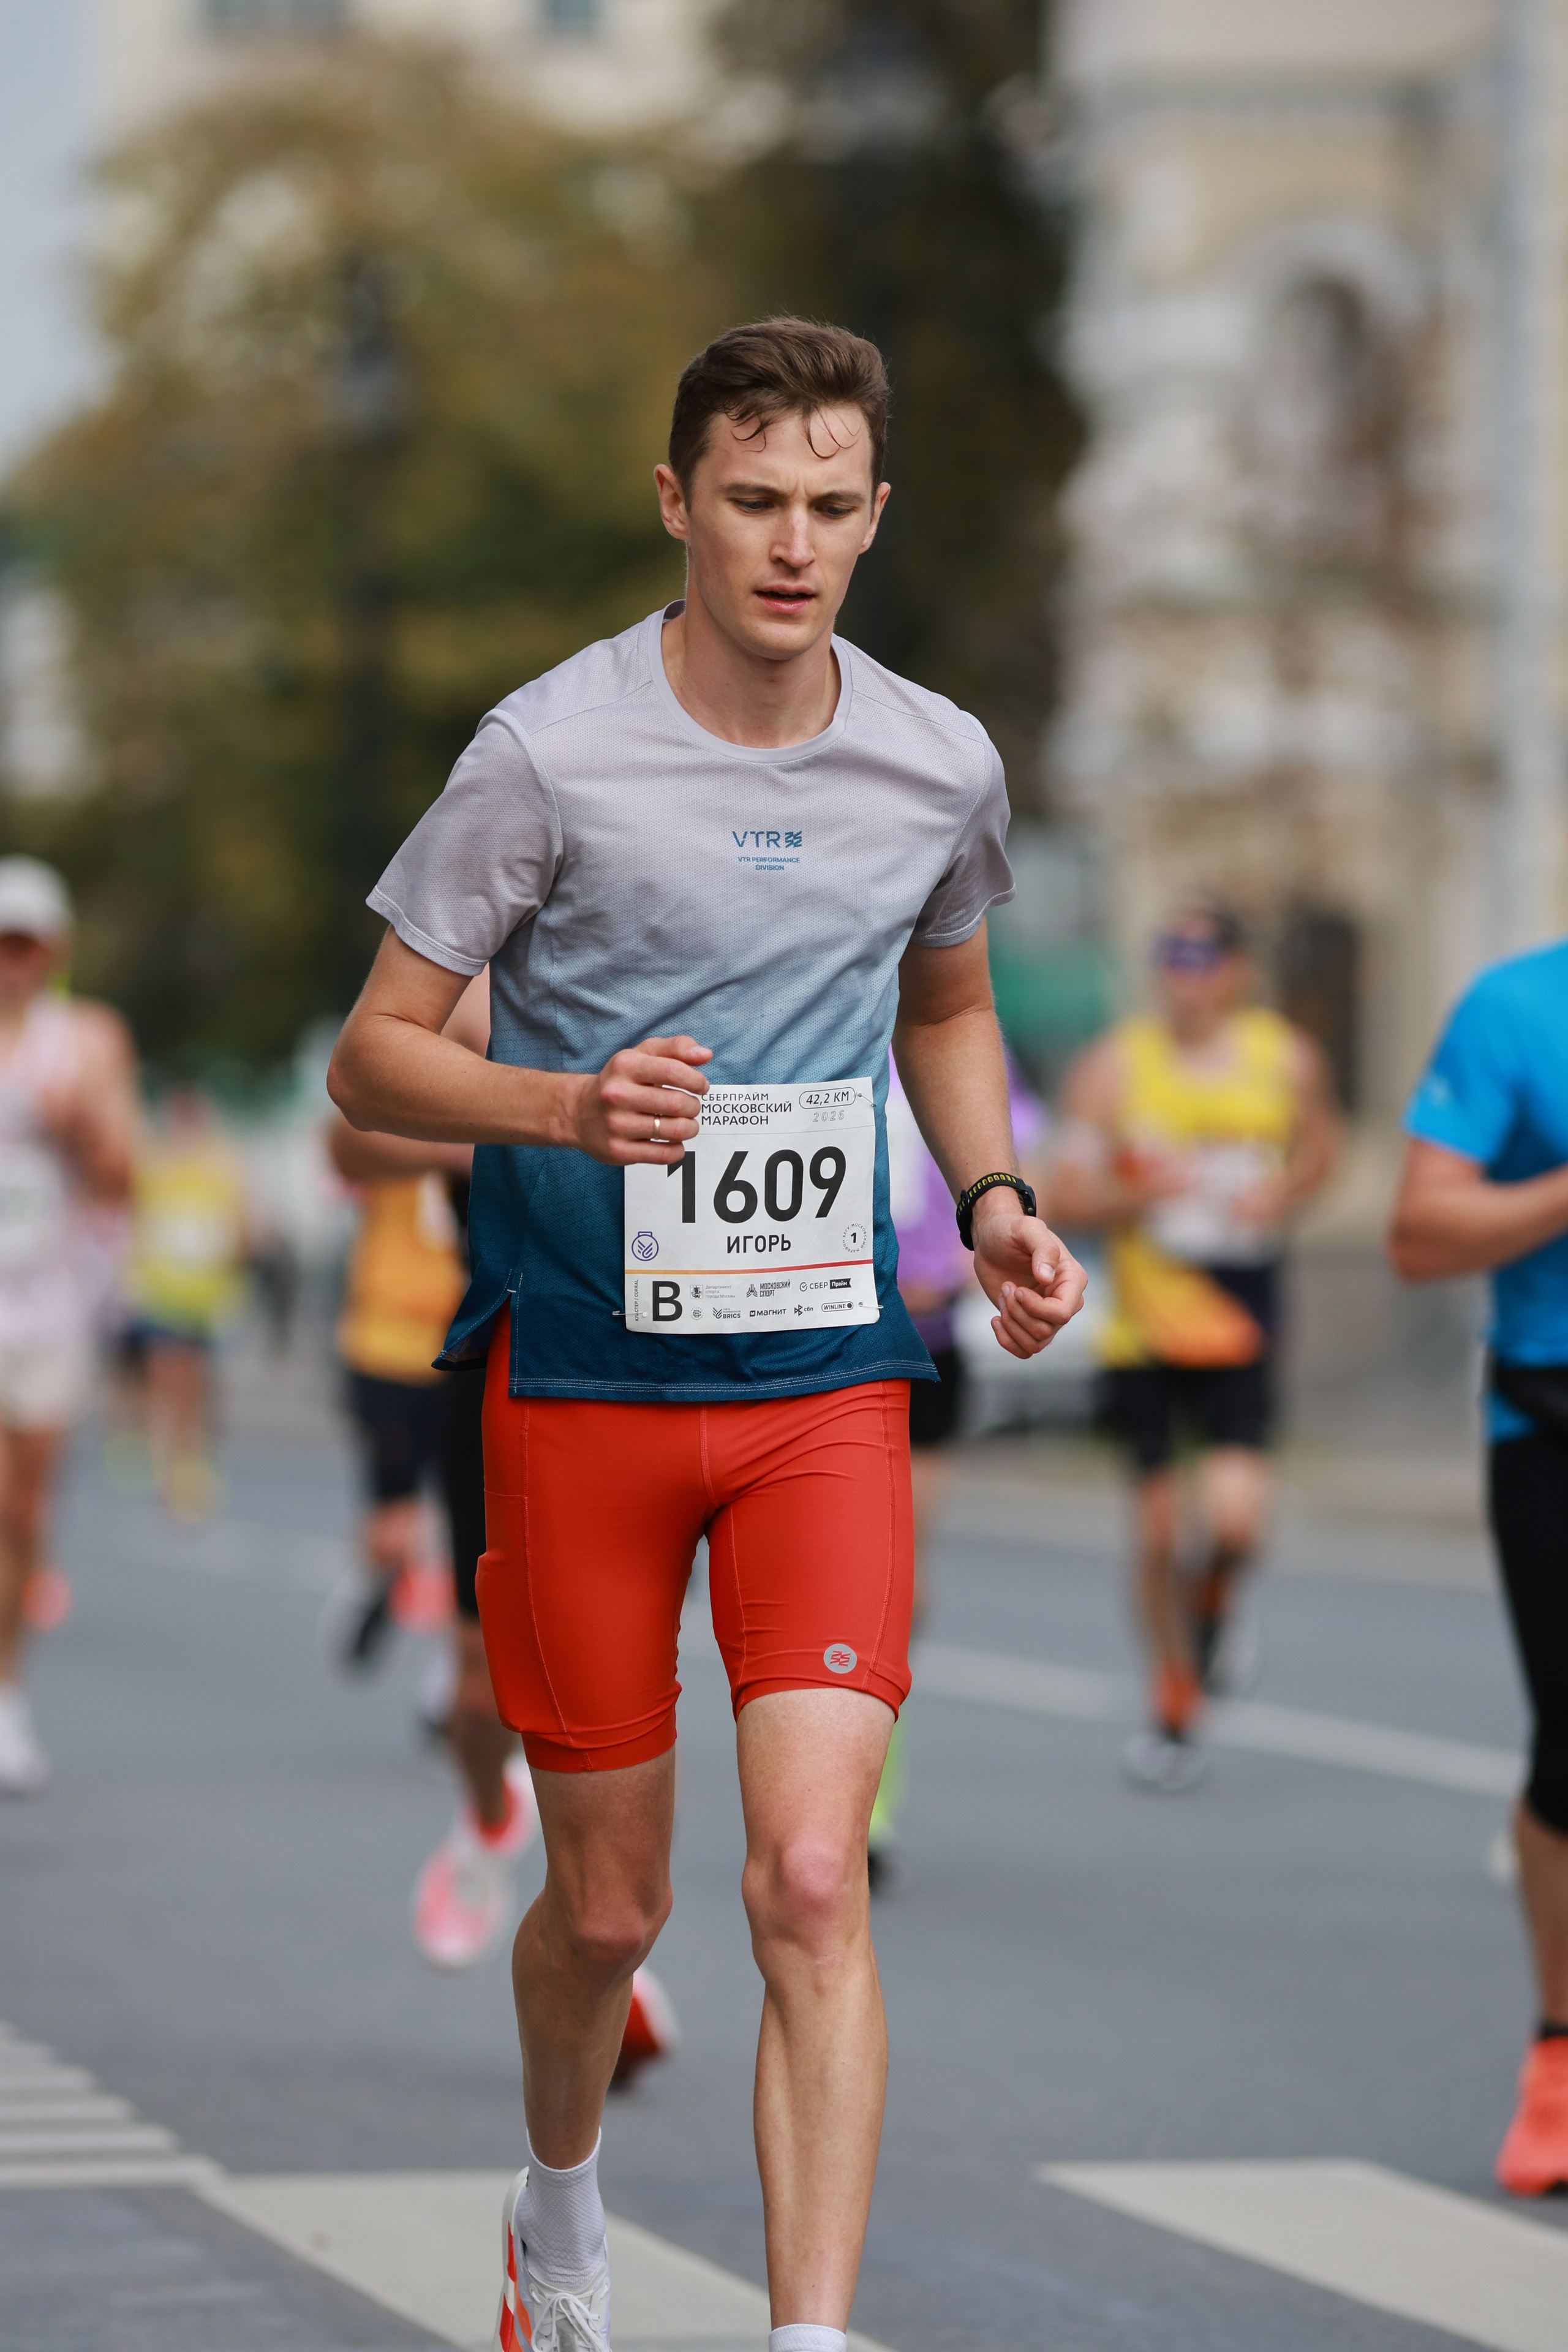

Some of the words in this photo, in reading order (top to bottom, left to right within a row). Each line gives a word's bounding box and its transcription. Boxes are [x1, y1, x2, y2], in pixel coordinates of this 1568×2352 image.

[732, 831, 780, 848] VTR
[701, 1092, 769, 1101] СБЕРПРАЙМ
[806, 1093, 831, 1106] 42,2
[701, 1101, 792, 1114] МОСКОВСКИЙ
[701, 1115, 769, 1125] МАРАФОН
[812, 1110, 845, 1123] 2026
[667, 1146, 846, 1224] 1609
[726, 1234, 791, 1254] ИГОРЬ
[850, 1232, 857, 1243] 1
[760, 1280, 791, 1290] МОСКОВСКИЙ
